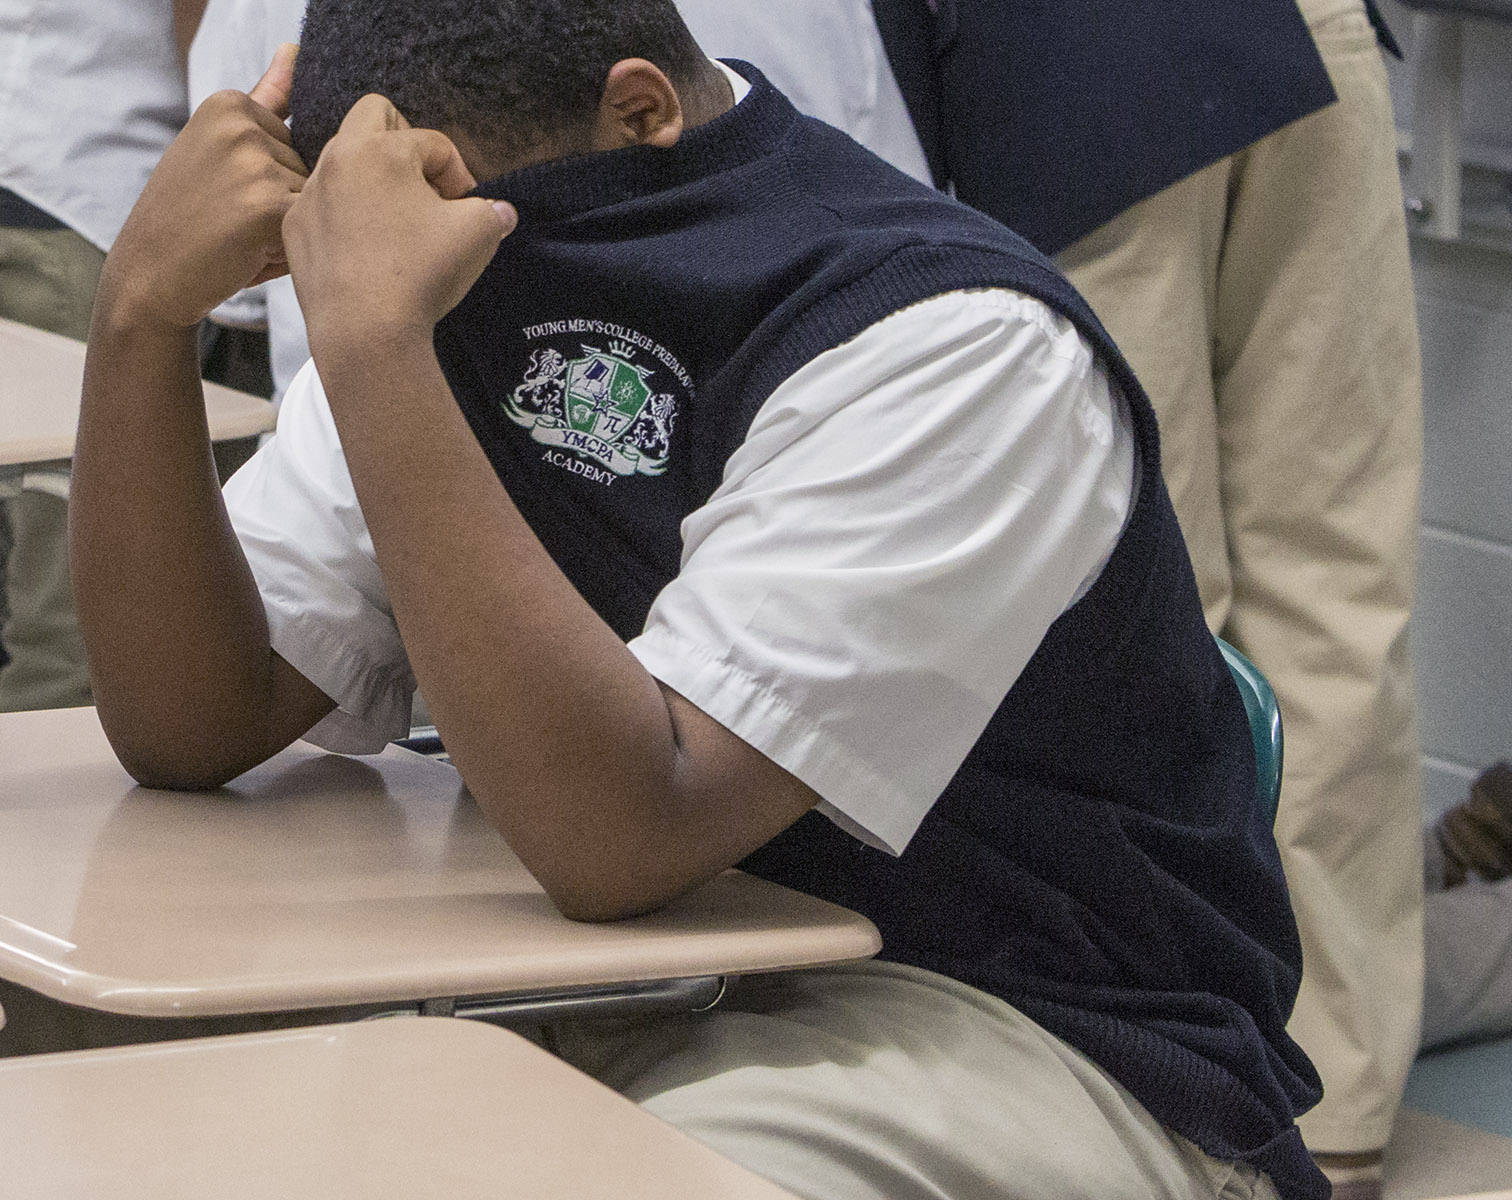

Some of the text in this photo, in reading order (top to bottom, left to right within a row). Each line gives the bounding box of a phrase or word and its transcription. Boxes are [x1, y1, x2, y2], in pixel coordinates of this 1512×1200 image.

[523, 320, 567, 339] YOUNG
[568, 319, 604, 333] MEN'S
[604, 322, 653, 351] COLLEGE
[562, 430, 614, 462] YMCPA
[541, 450, 617, 487] ACADEMY
